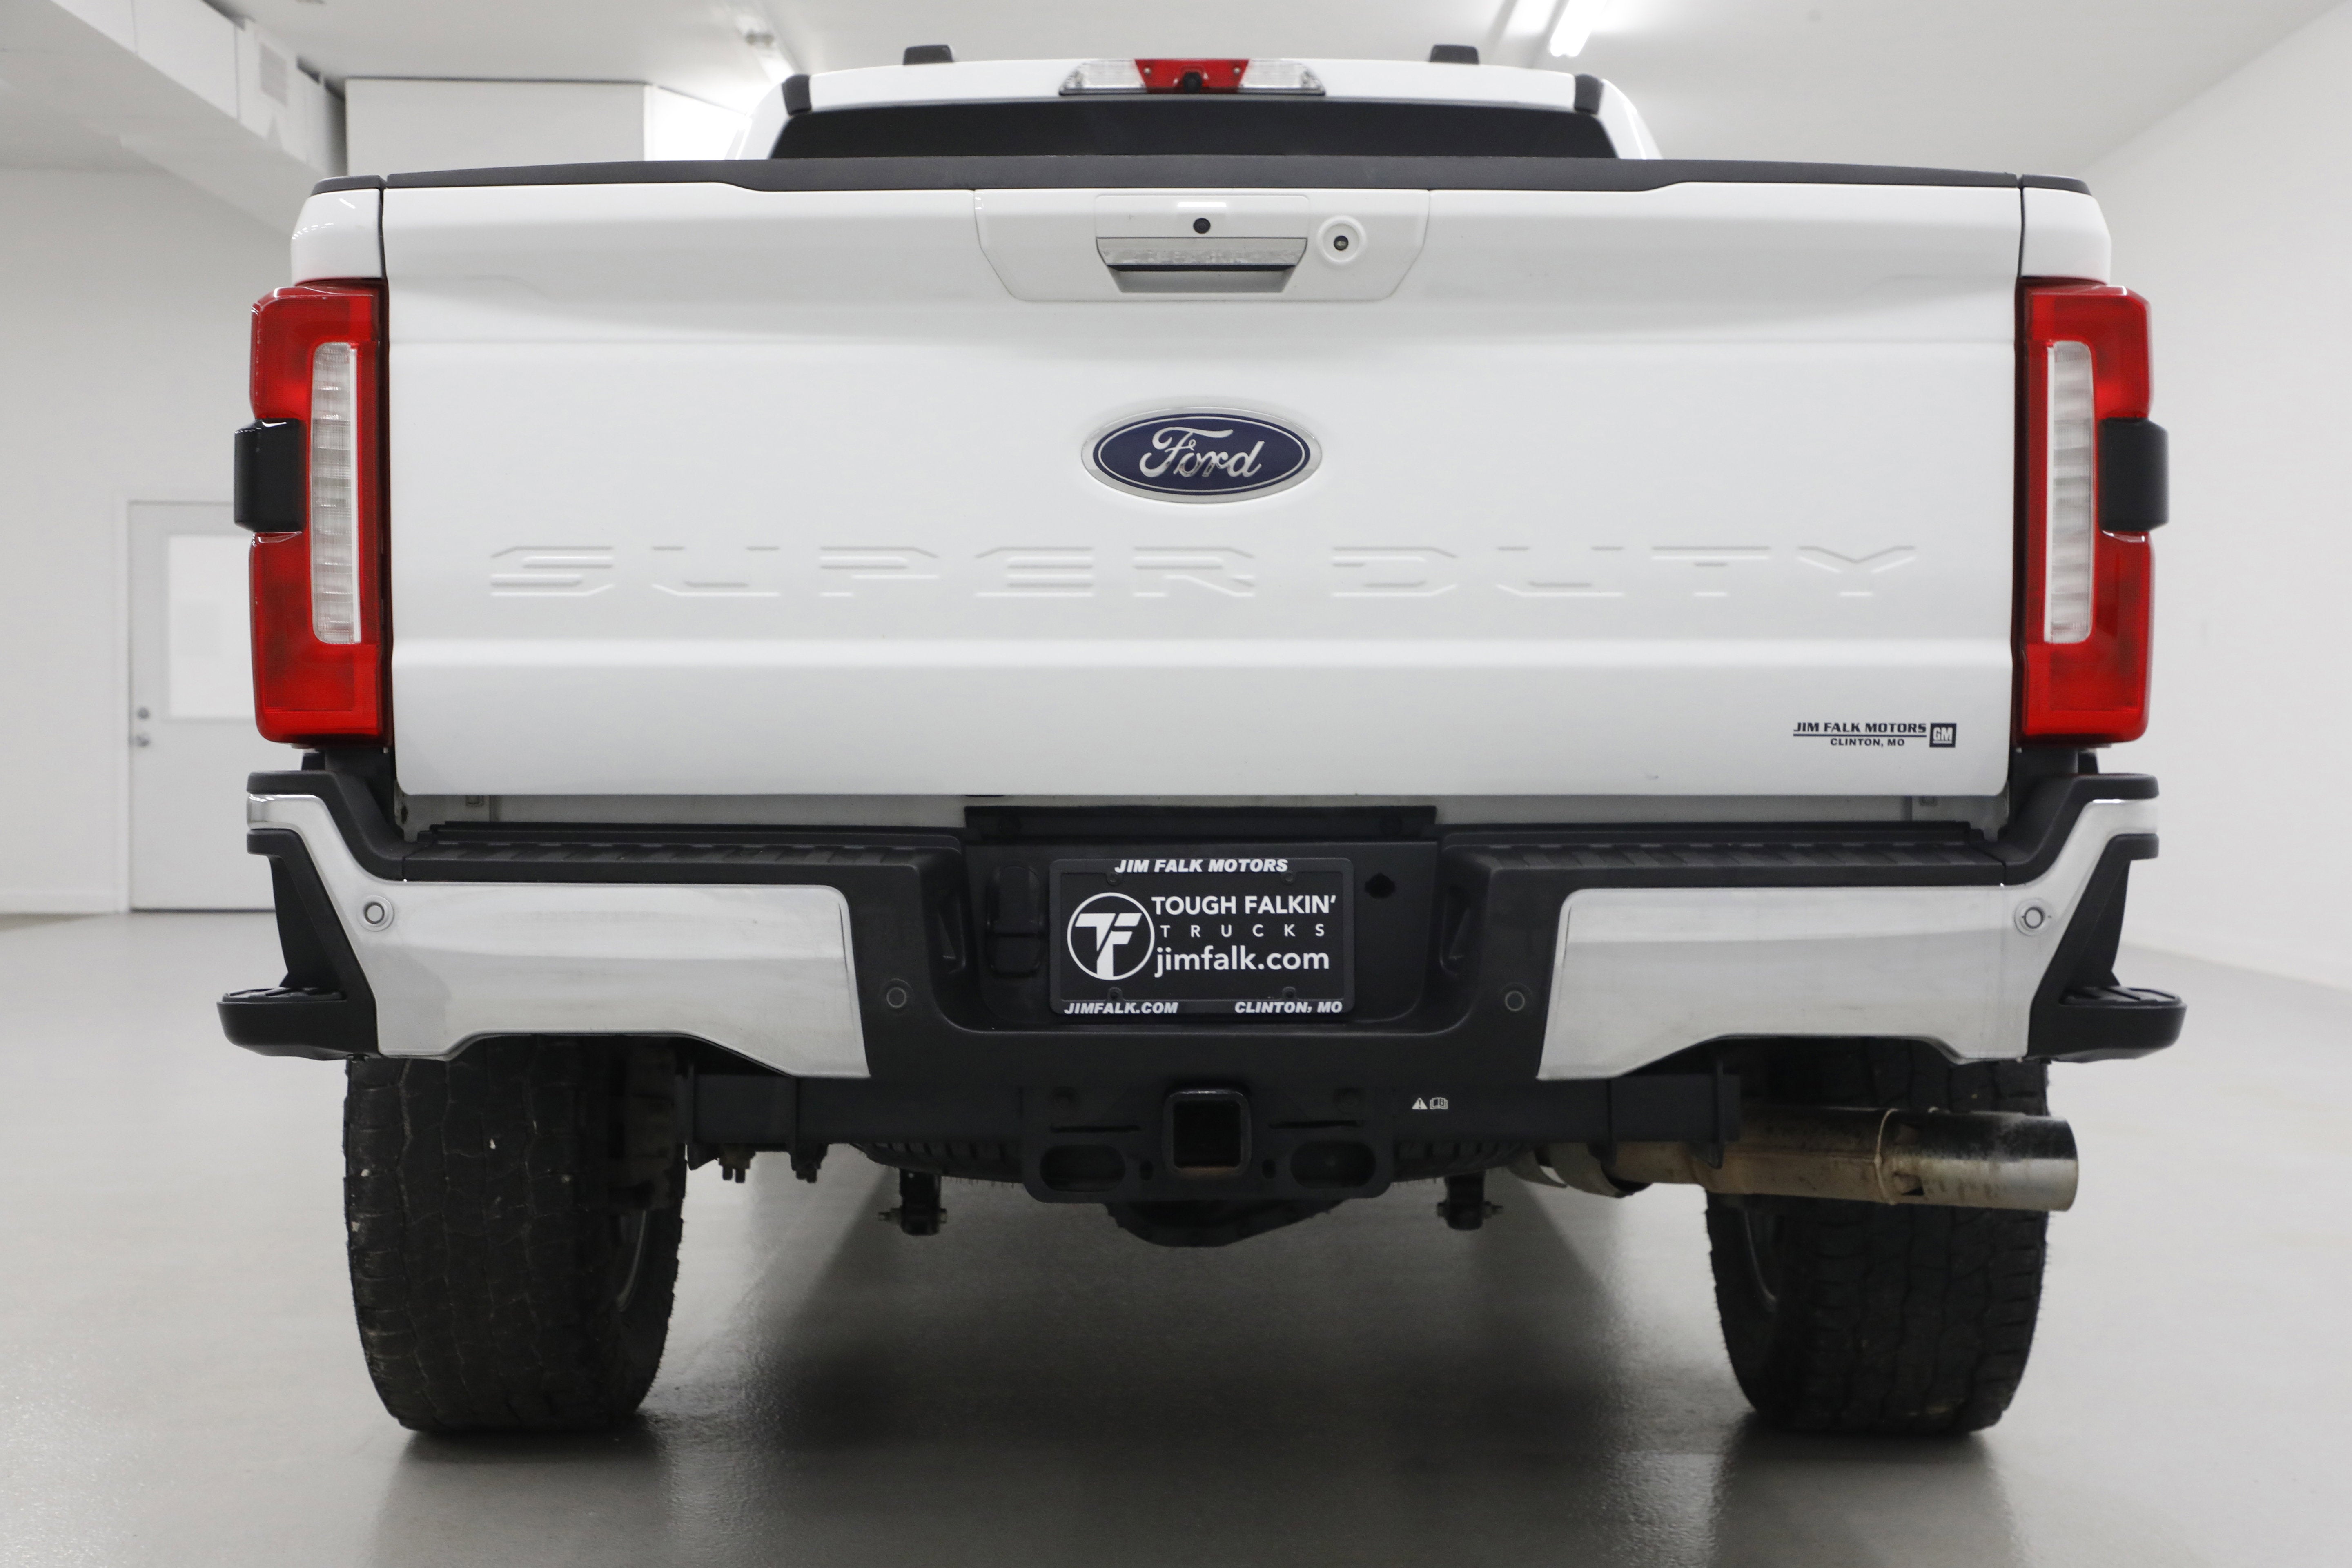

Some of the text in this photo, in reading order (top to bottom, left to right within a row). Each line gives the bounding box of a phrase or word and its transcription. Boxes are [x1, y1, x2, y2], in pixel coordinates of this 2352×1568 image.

[1139, 426, 1265, 478] Ford
[490, 546, 1917, 597] SUPER DUTY
[1793, 722, 1927, 733] JIM FALK MOTORS
[1933, 726, 1953, 741] GM
[1830, 738, 1905, 748] CLINTON, MO
[1114, 858, 1289, 873] JIM FALK MOTORS
[1151, 895, 1237, 915] TOUGH
[1160, 923, 1325, 938] TRUCKS
[1154, 945, 1330, 978] jimfalk.com
[1063, 1002, 1179, 1015] JIMFALK.COM
[1234, 1001, 1343, 1014] CLINTON, MO
